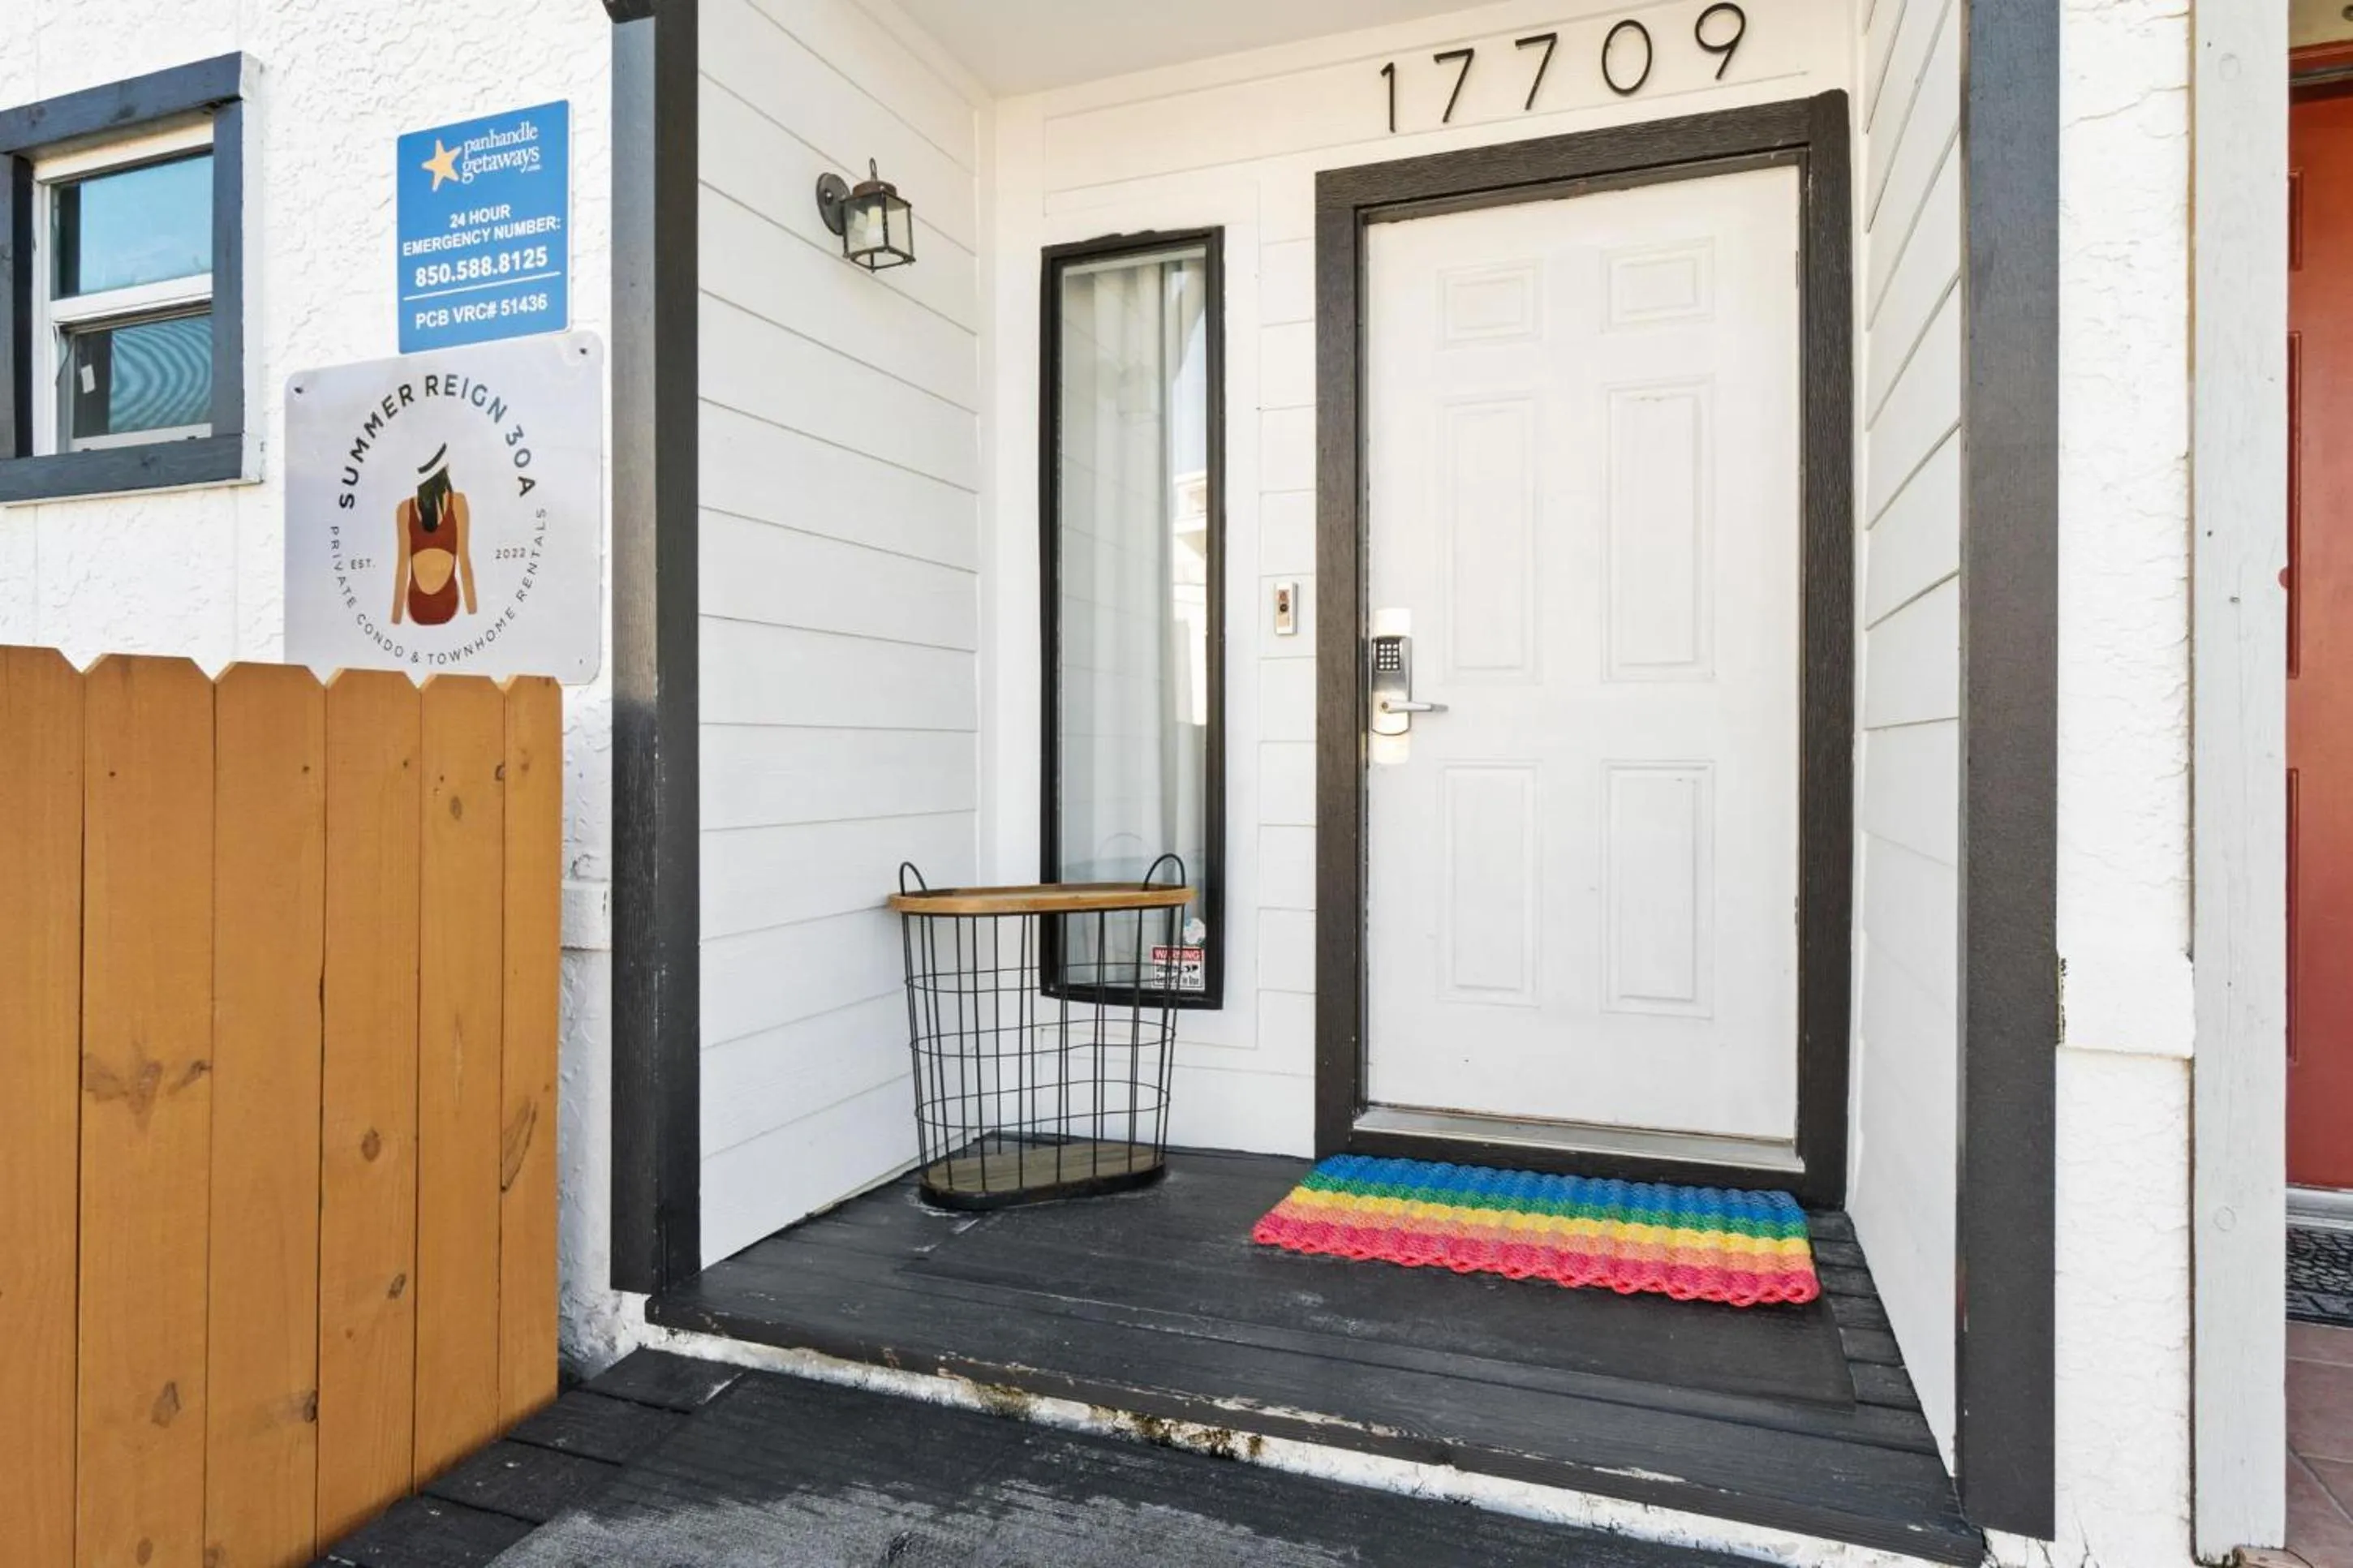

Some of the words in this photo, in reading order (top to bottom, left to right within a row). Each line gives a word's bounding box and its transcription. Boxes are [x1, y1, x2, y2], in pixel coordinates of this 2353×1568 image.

[1380, 2, 1746, 132] 17709
[464, 122, 539, 160] panhandle
[462, 144, 540, 184] getaways
[402, 228, 490, 256] EMERGENCY
[493, 216, 561, 242] NUMBER:
[450, 213, 466, 229] 24
[469, 204, 511, 225] HOUR
[415, 247, 548, 287] 850.588.8125
[415, 311, 450, 329] PCB
[452, 304, 497, 324] VRC#
[501, 294, 548, 316] 51436
[339, 383, 415, 509] SUMMER
[425, 374, 508, 423] REIGN
[505, 424, 536, 497] 30A
[351, 558, 376, 570] EST.
[495, 547, 527, 560] 2022
[329, 526, 358, 609] PRIVATE
[356, 613, 404, 659] CONDO
[411, 651, 419, 664] &
[428, 607, 516, 665] TOWNHOME
[516, 508, 548, 603] RENTALS
